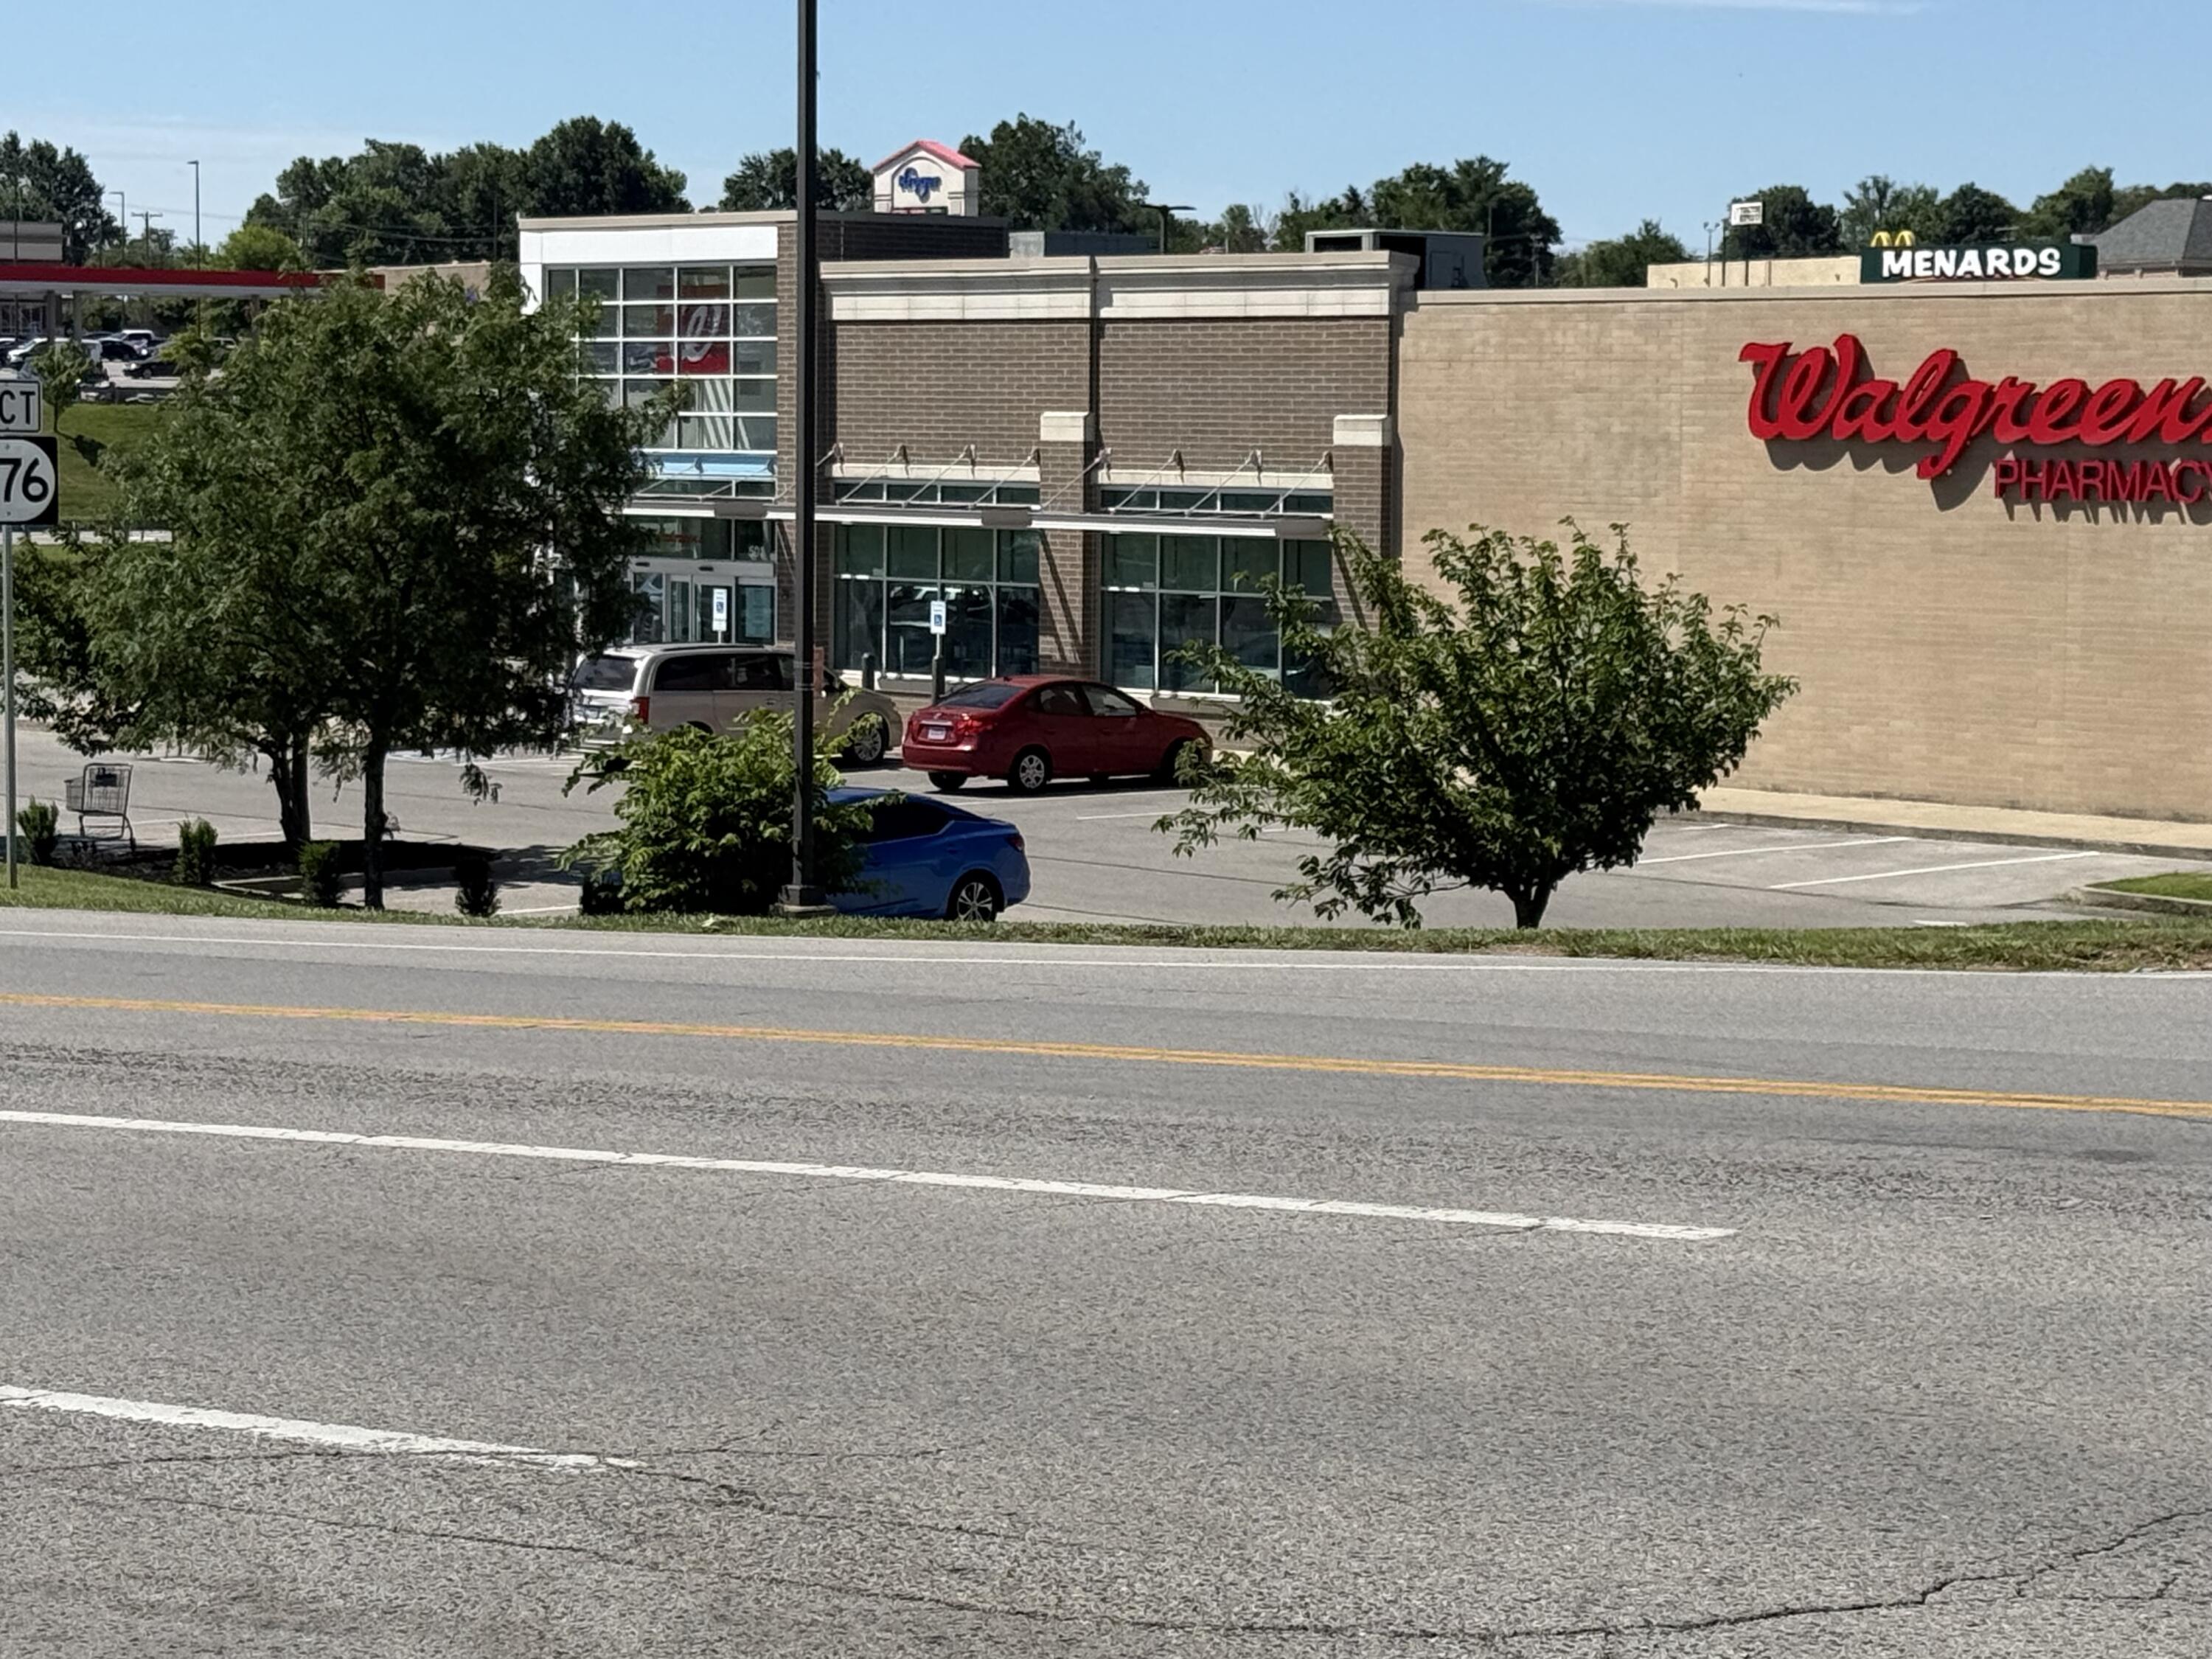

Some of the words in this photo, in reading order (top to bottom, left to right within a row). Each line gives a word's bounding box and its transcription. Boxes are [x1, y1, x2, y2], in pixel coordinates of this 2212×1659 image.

[1882, 248, 2061, 277] MENARDS
[1738, 333, 2212, 480] Walgreen
[0, 458, 49, 503] 76
